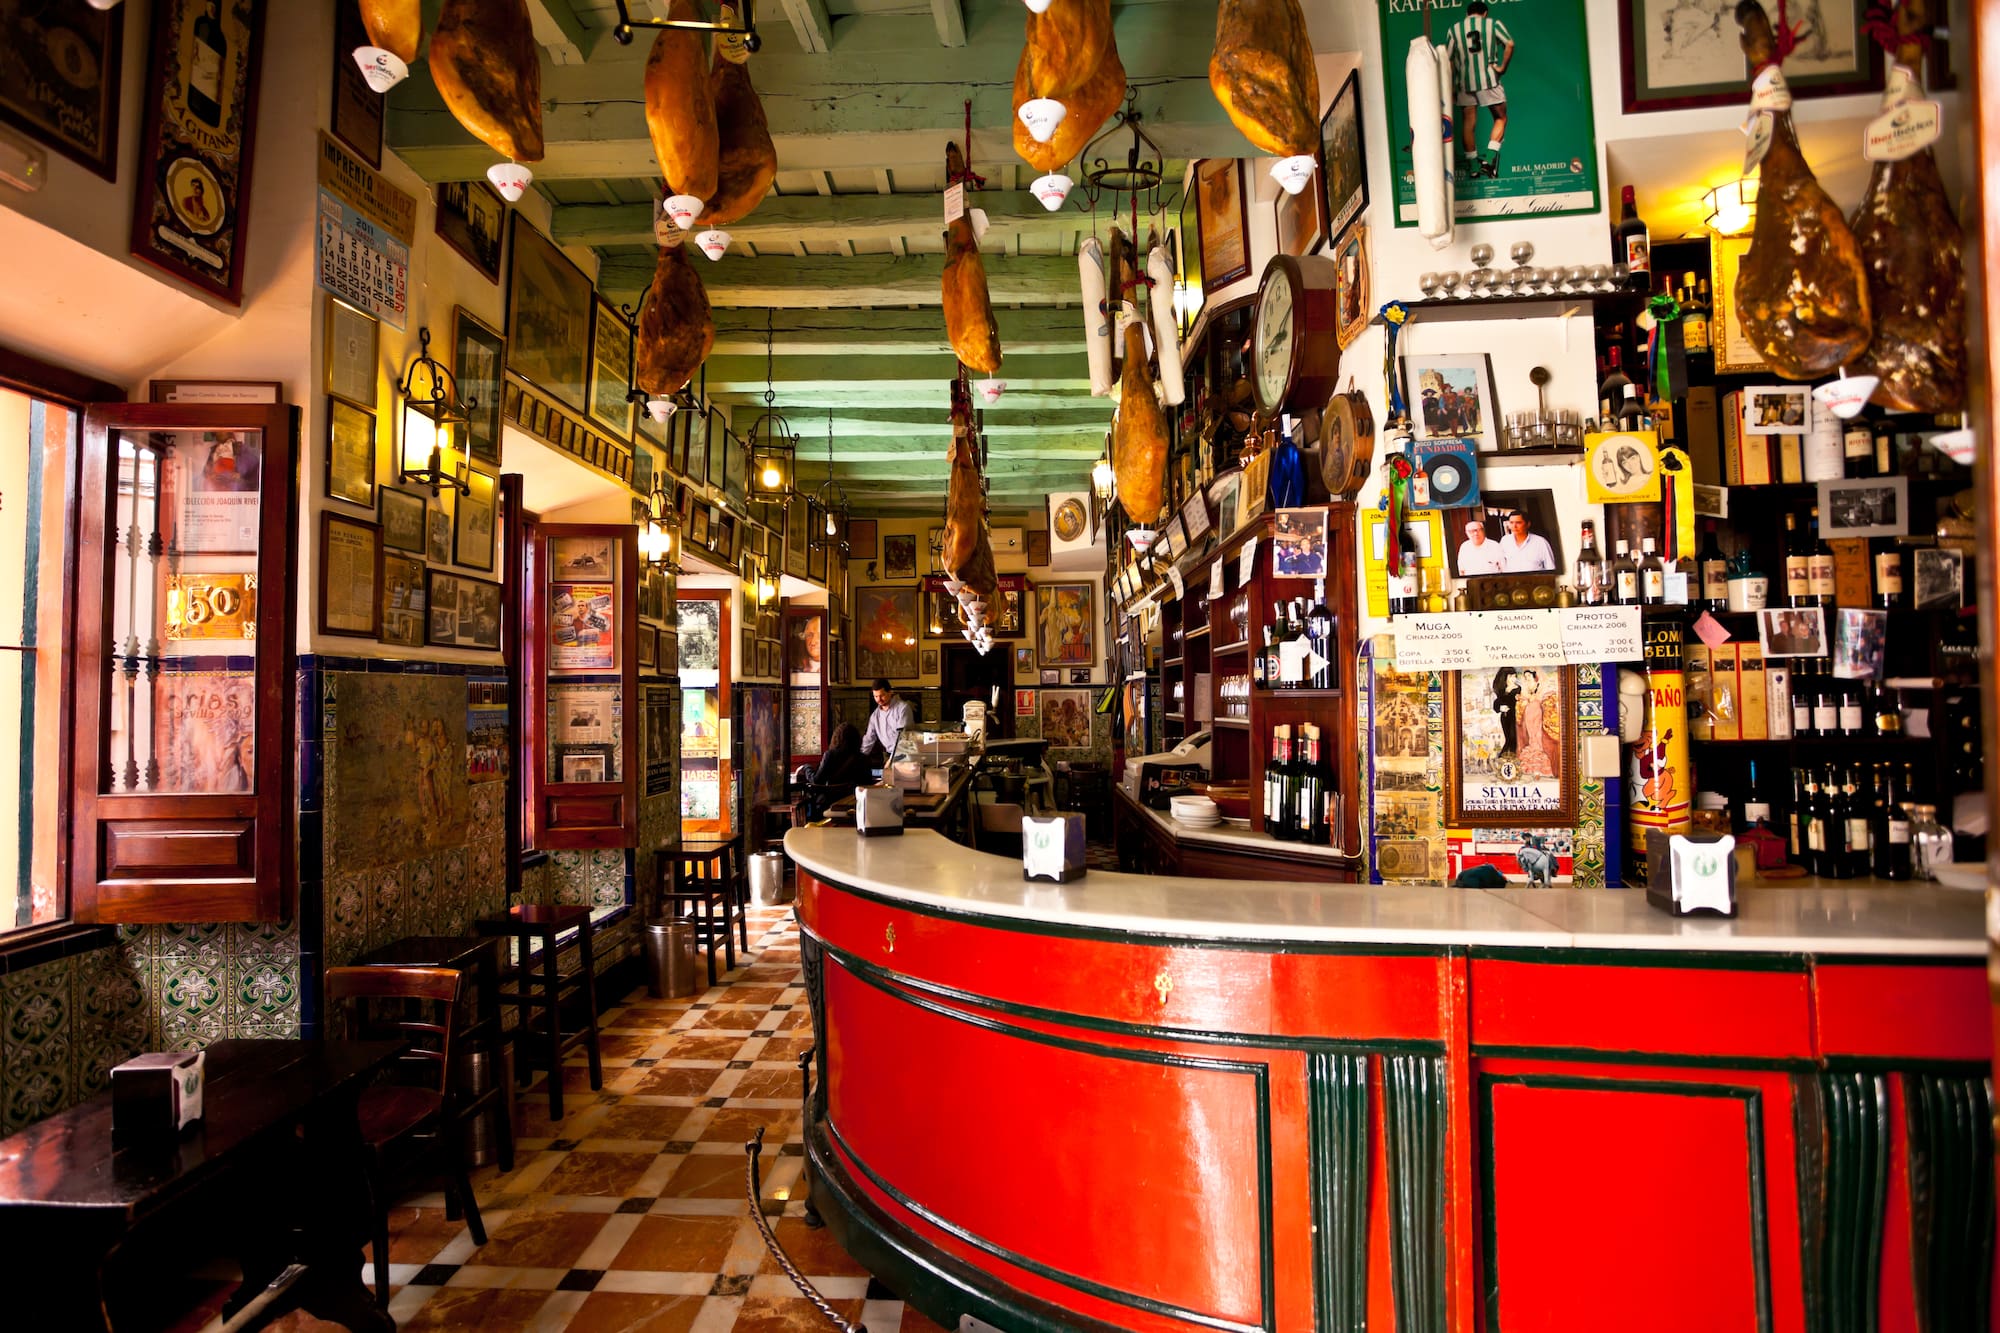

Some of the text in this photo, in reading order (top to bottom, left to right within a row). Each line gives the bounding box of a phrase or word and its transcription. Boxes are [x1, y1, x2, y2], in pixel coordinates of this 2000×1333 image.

[1466, 30, 1482, 54] 3
[185, 119, 235, 150] GITANA
[1511, 162, 1566, 173] REAL MADRID
[356, 217, 374, 236] 2011
[326, 234, 404, 290] 7 8 9 10 11 12 13
[352, 238, 357, 248] 2
[364, 246, 369, 256] 3
[375, 254, 380, 262] 4
[386, 260, 392, 271] 5
[398, 267, 403, 278] 6
[325, 247, 405, 303] 14 15 16 17 18 19 20
[325, 260, 405, 314] 21 22 23 24 25 26 27
[325, 273, 370, 308] 28 29 30 31
[1413, 444, 1466, 454] FUNDADOR
[186, 585, 240, 626] 50
[1416, 622, 1451, 631] MUGA
[1482, 786, 1542, 798] SEVILLA
